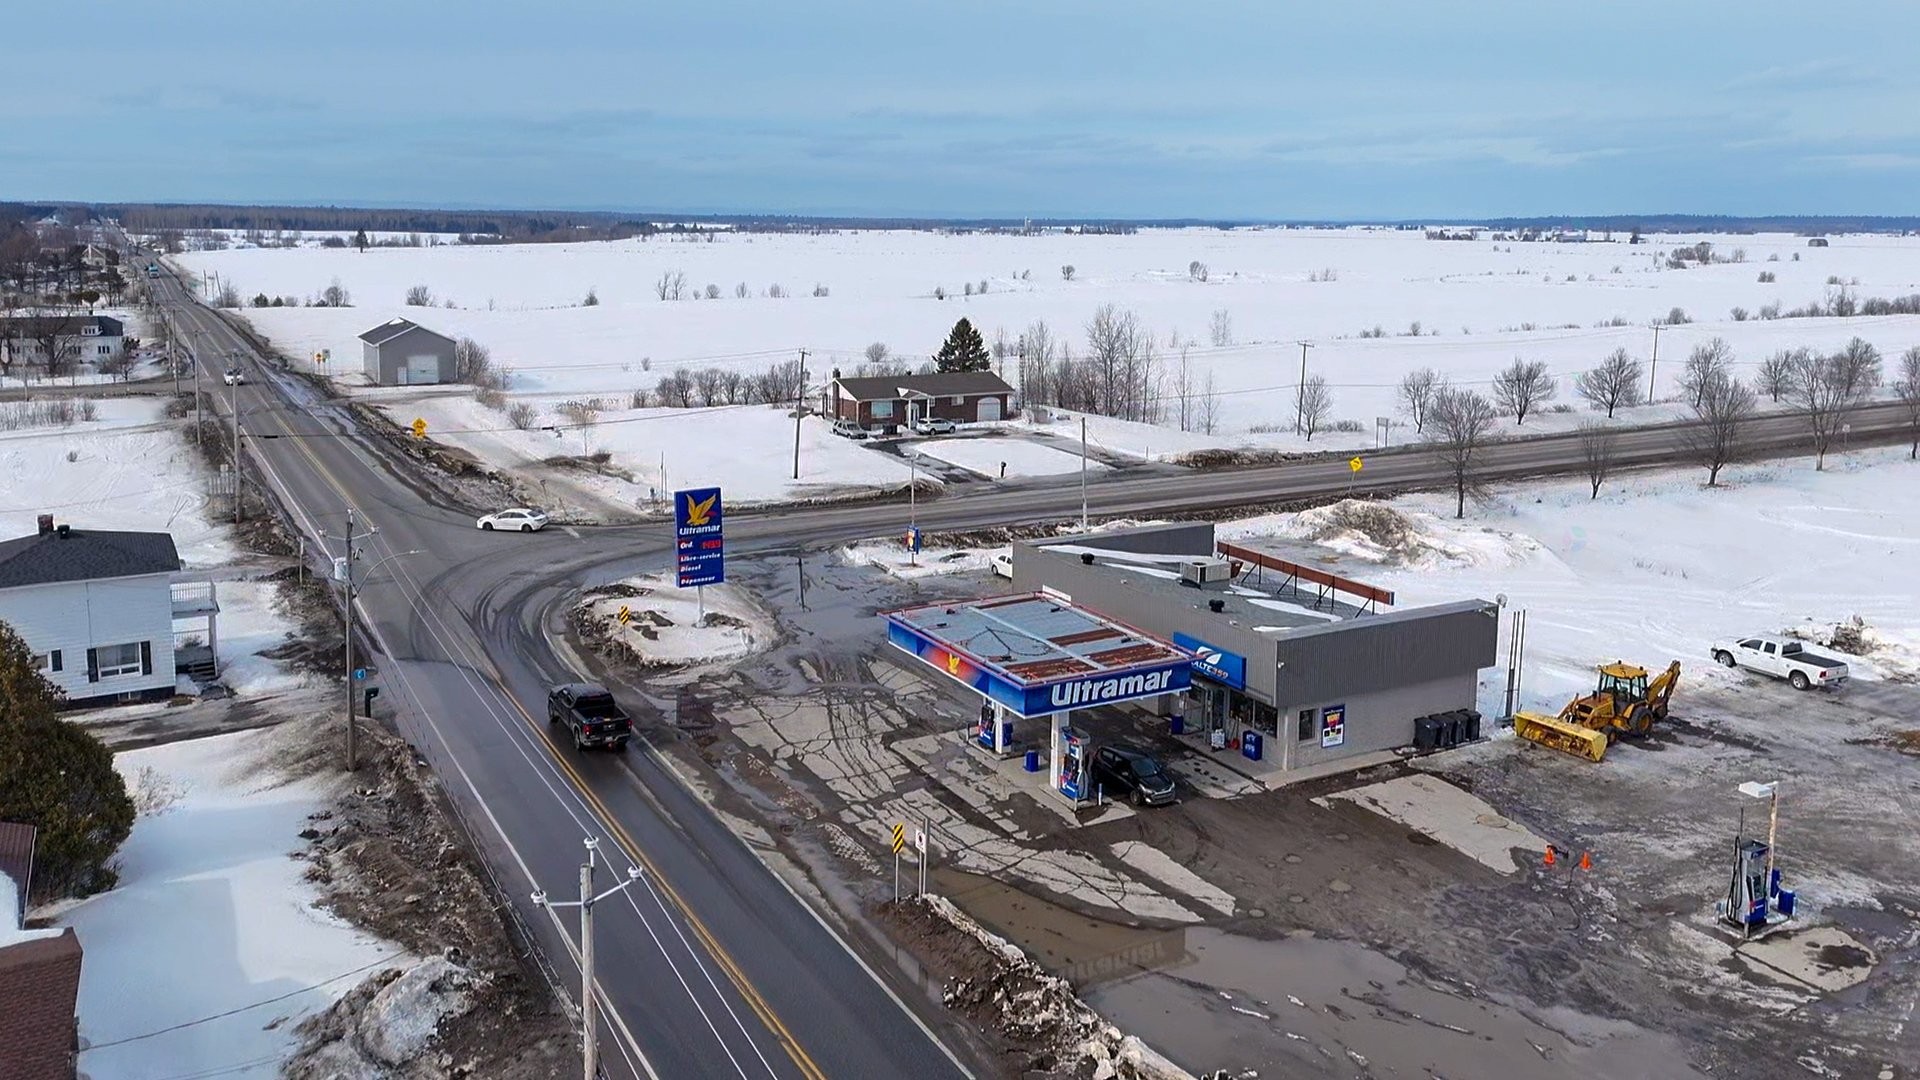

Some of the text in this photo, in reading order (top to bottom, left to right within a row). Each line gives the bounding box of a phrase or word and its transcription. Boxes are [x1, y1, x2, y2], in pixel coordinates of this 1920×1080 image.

[680, 525, 720, 535] Ultramar
[1191, 660, 1229, 680] ALTE359
[1051, 670, 1172, 706] Ultramar
